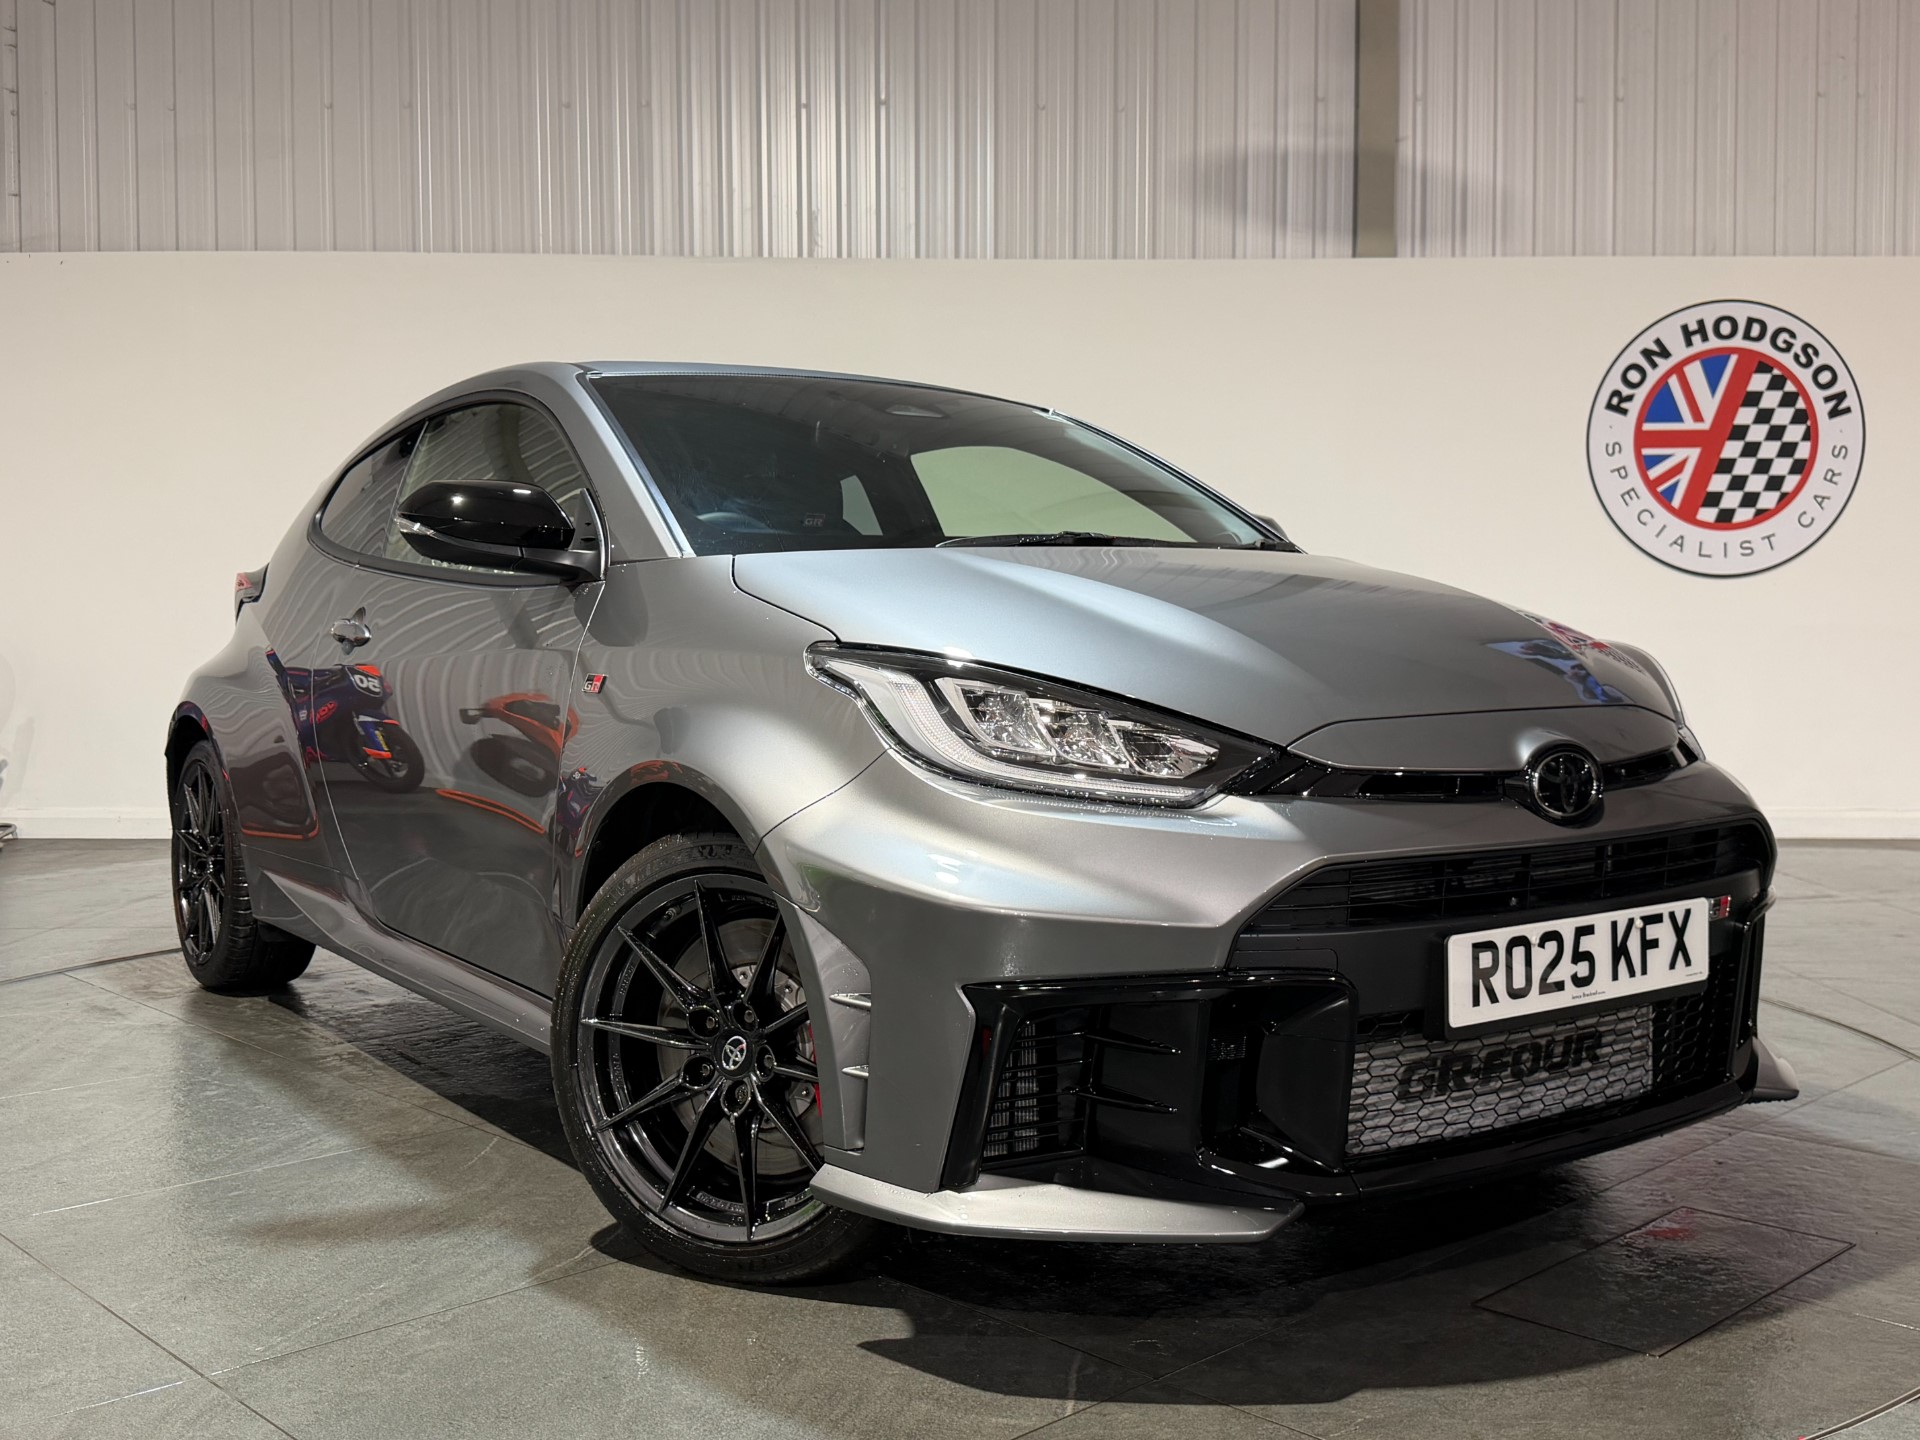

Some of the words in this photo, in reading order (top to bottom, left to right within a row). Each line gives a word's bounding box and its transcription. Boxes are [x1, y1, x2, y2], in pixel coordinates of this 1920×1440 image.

[1604, 338, 1672, 417] RON
[1680, 315, 1852, 420] HODGSON
[1605, 441, 1776, 558] SPECIALIST
[1797, 444, 1848, 529] CARS
[1610, 908, 1692, 982] KFX
